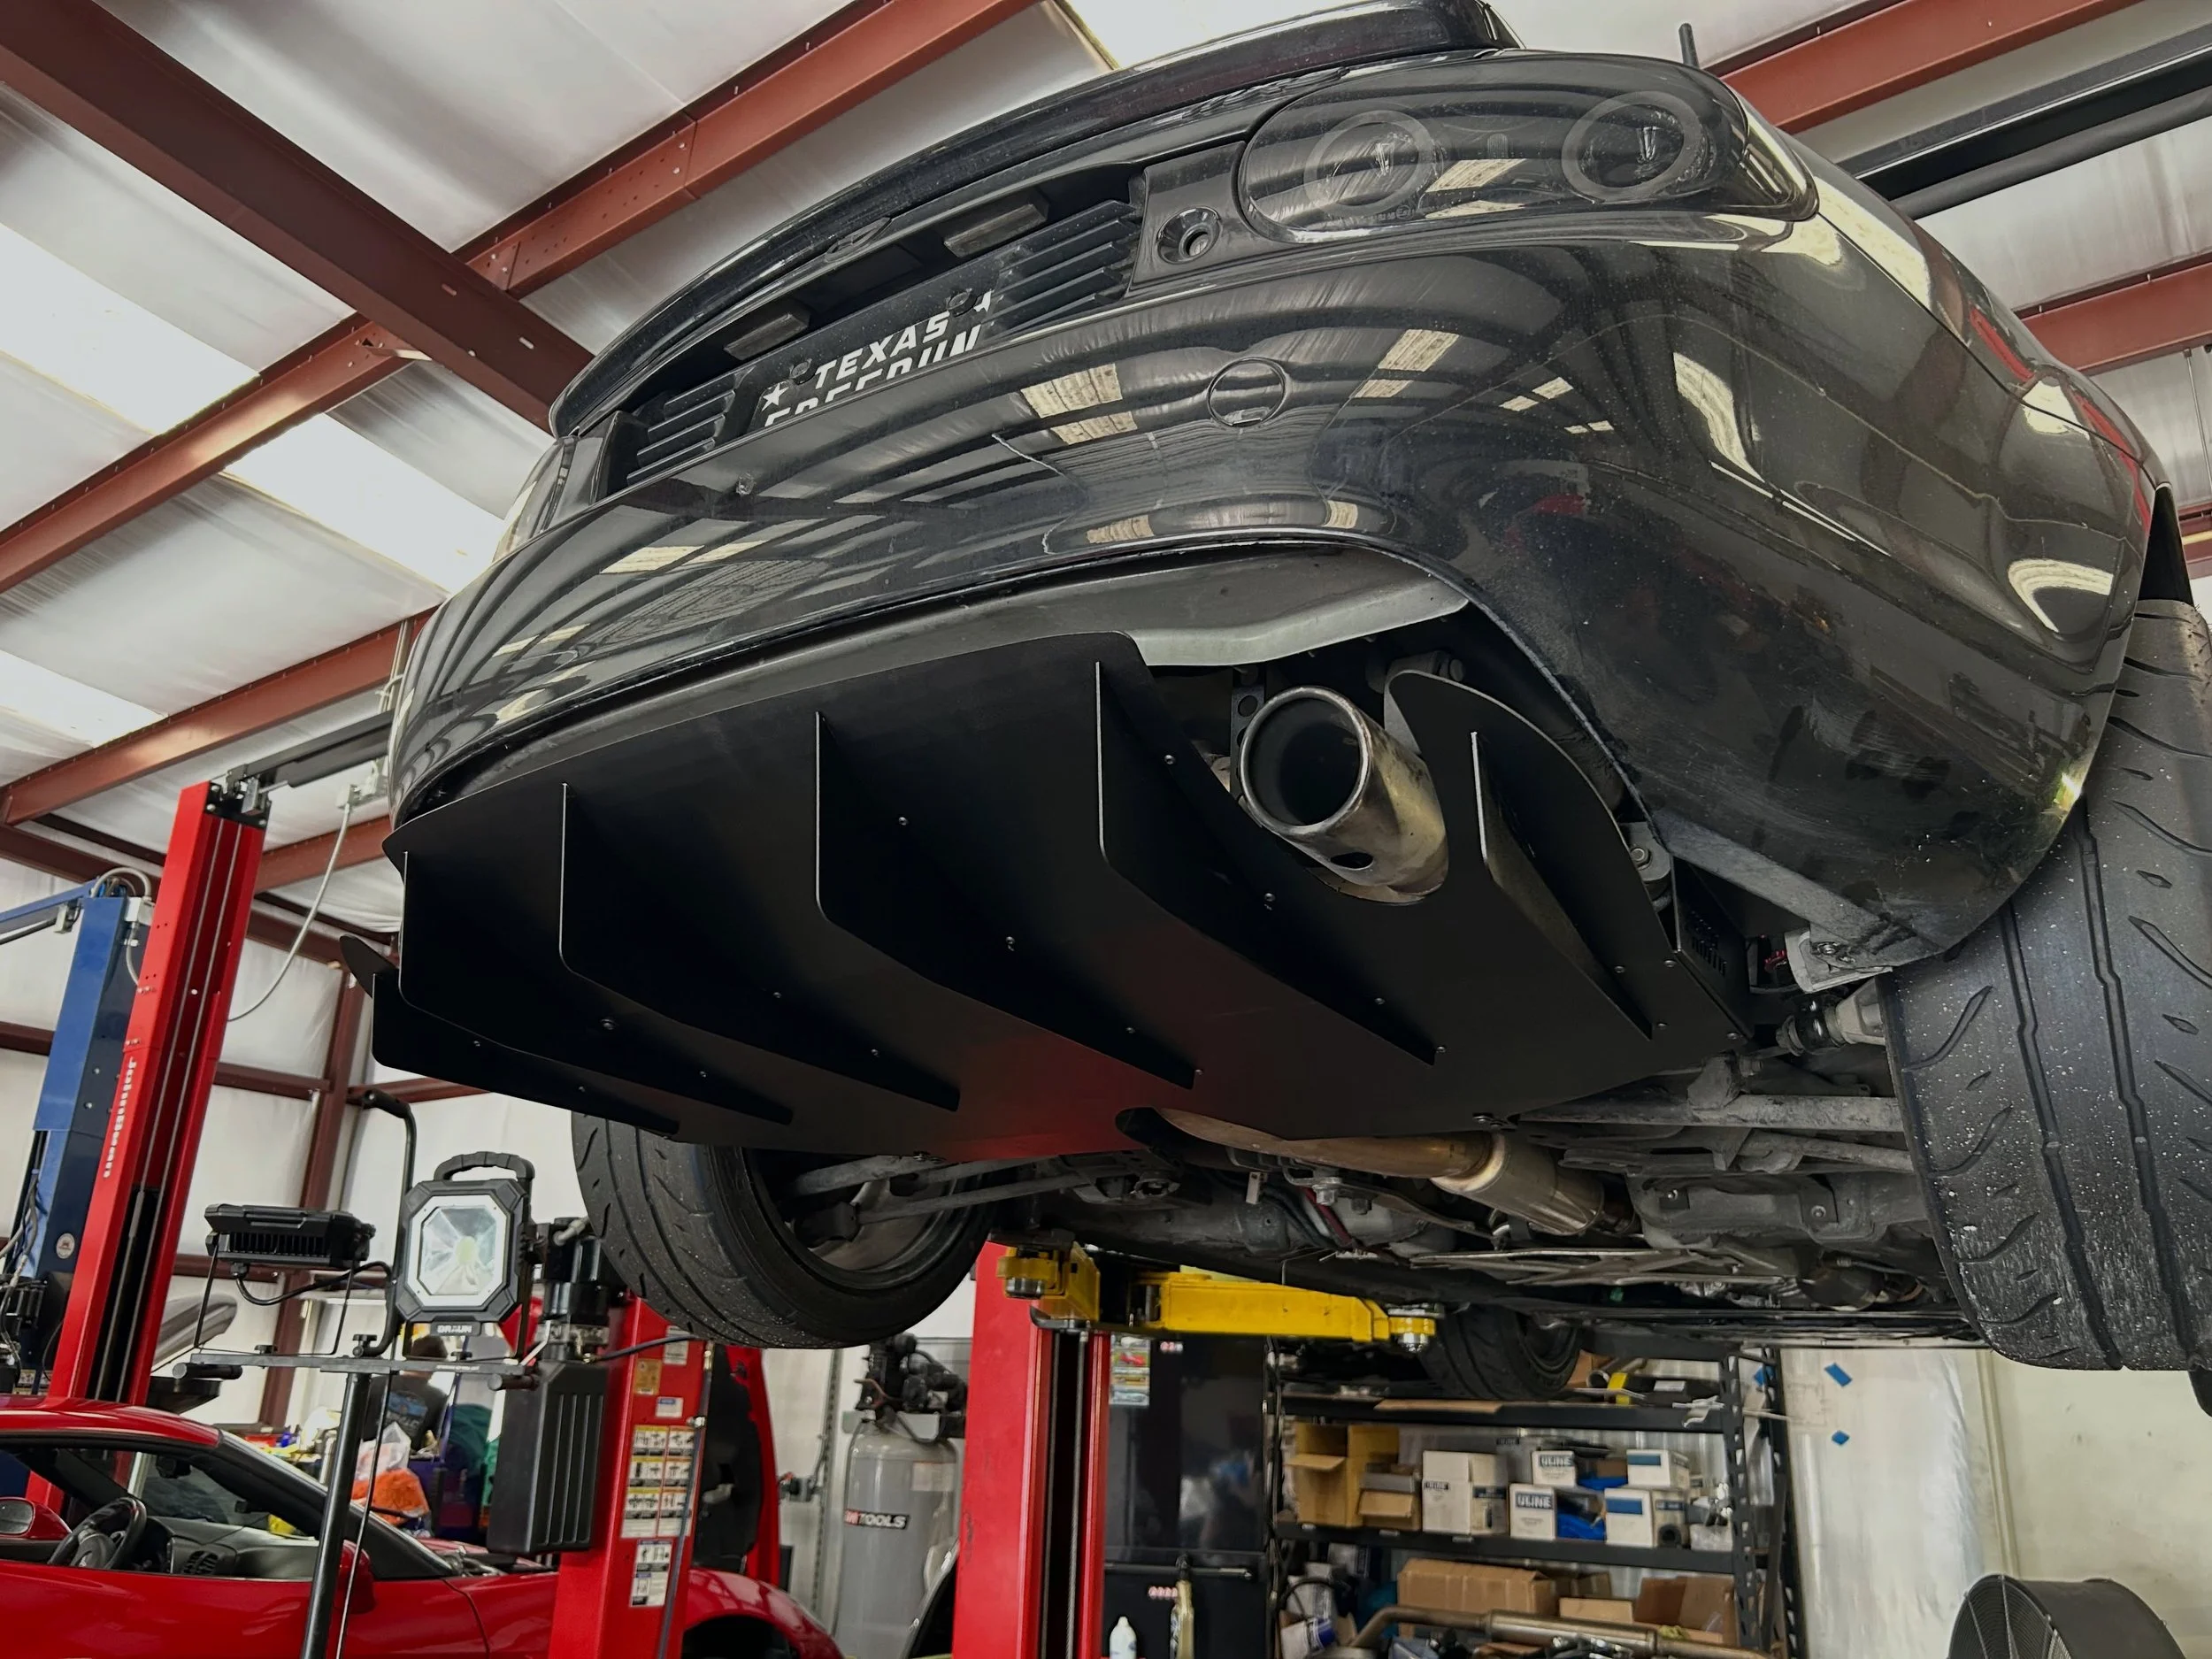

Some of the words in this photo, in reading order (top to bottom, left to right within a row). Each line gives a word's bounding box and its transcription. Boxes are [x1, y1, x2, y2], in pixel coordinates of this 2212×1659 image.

[815, 311, 950, 389] TEXAS
[1540, 1455, 1571, 1466] ULINE
[1517, 1494, 1552, 1509] ULINE
